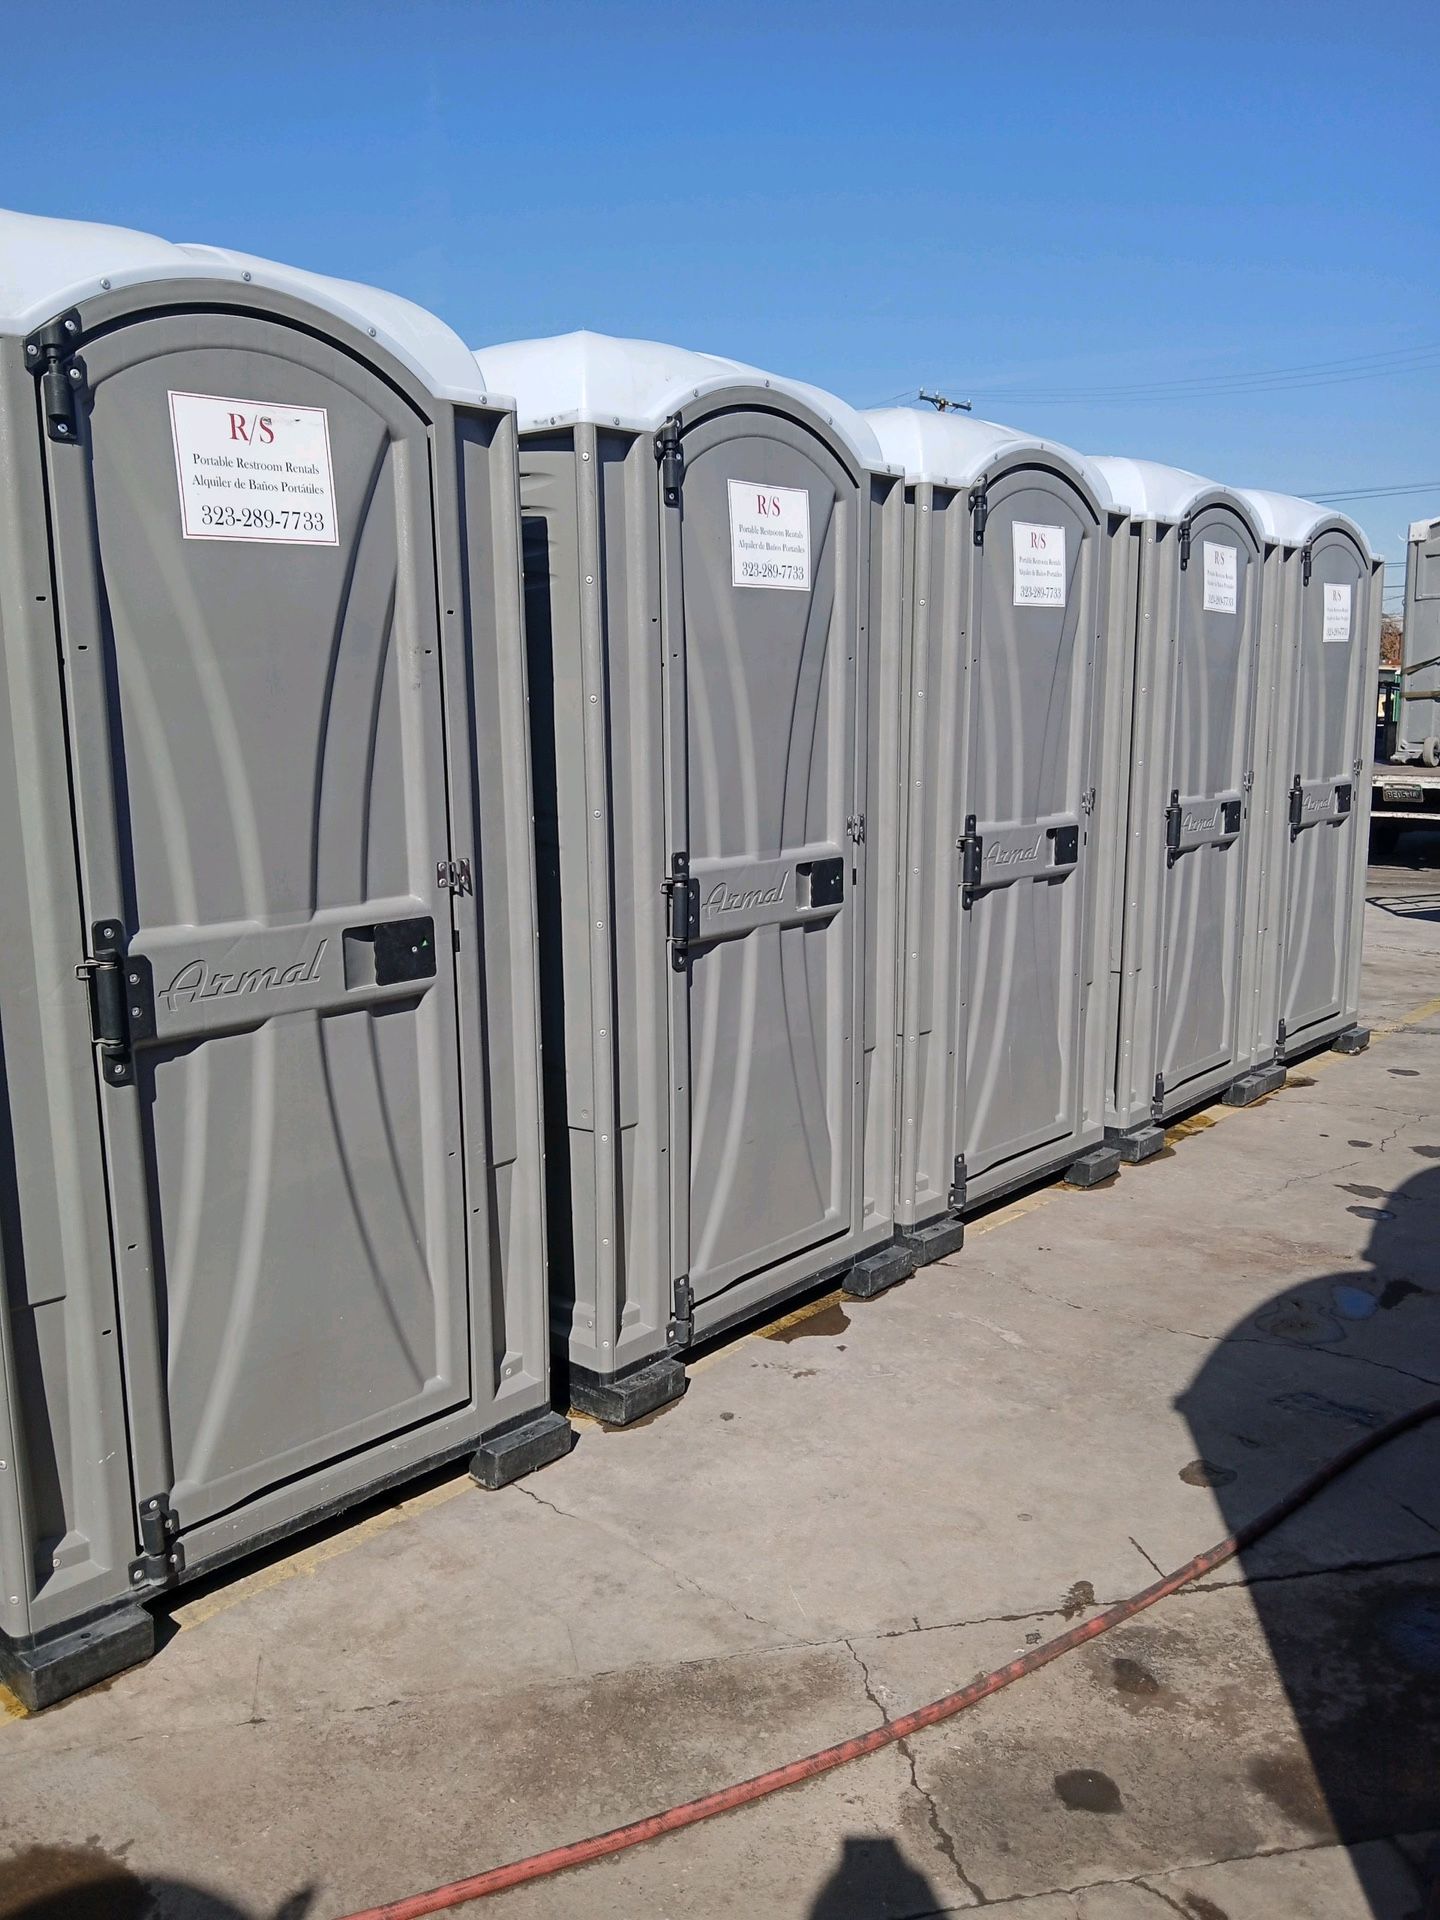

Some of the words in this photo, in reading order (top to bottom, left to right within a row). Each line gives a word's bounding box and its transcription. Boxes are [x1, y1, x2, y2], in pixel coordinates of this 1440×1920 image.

[227, 412, 275, 446] R/S
[192, 452, 234, 468] Portable
[236, 456, 283, 473] Restroom
[285, 461, 320, 475] Rentals
[192, 474, 232, 490] Alquiler
[234, 477, 246, 490] de
[248, 478, 279, 493] Baños
[281, 481, 325, 496] Portátiles
[201, 504, 325, 532] 323-289-7733
[756, 494, 781, 518] R/S
[741, 560, 805, 581] 323-289-7733
[982, 833, 1042, 872] Armal
[701, 870, 790, 920] Armal
[158, 938, 329, 1015] Armal
